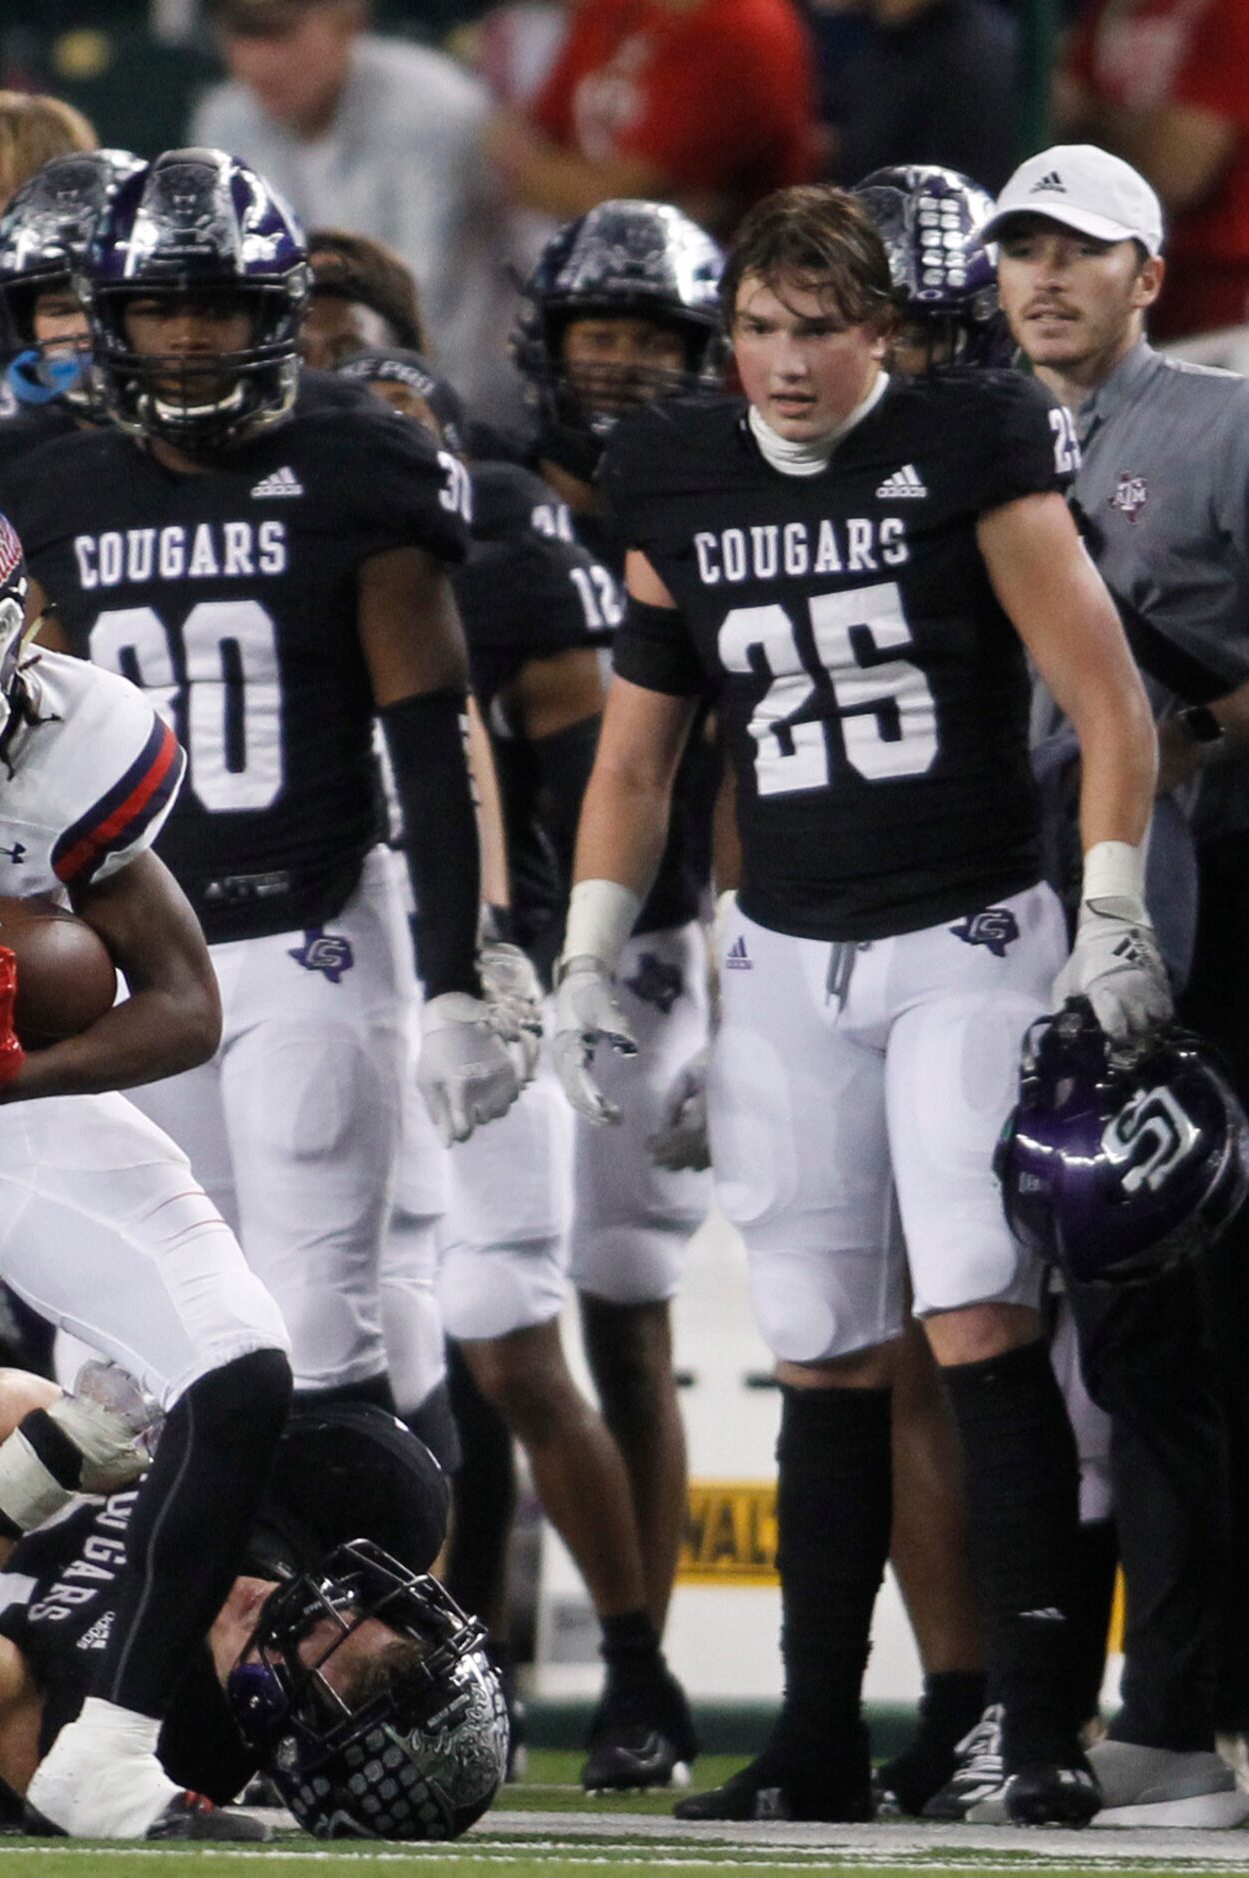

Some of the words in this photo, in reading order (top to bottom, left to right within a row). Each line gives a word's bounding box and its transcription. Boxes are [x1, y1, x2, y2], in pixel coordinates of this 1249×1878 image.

[74, 520, 287, 589] COUGARS
[694, 516, 910, 584] COUGARS
[718, 581, 939, 796] 25
